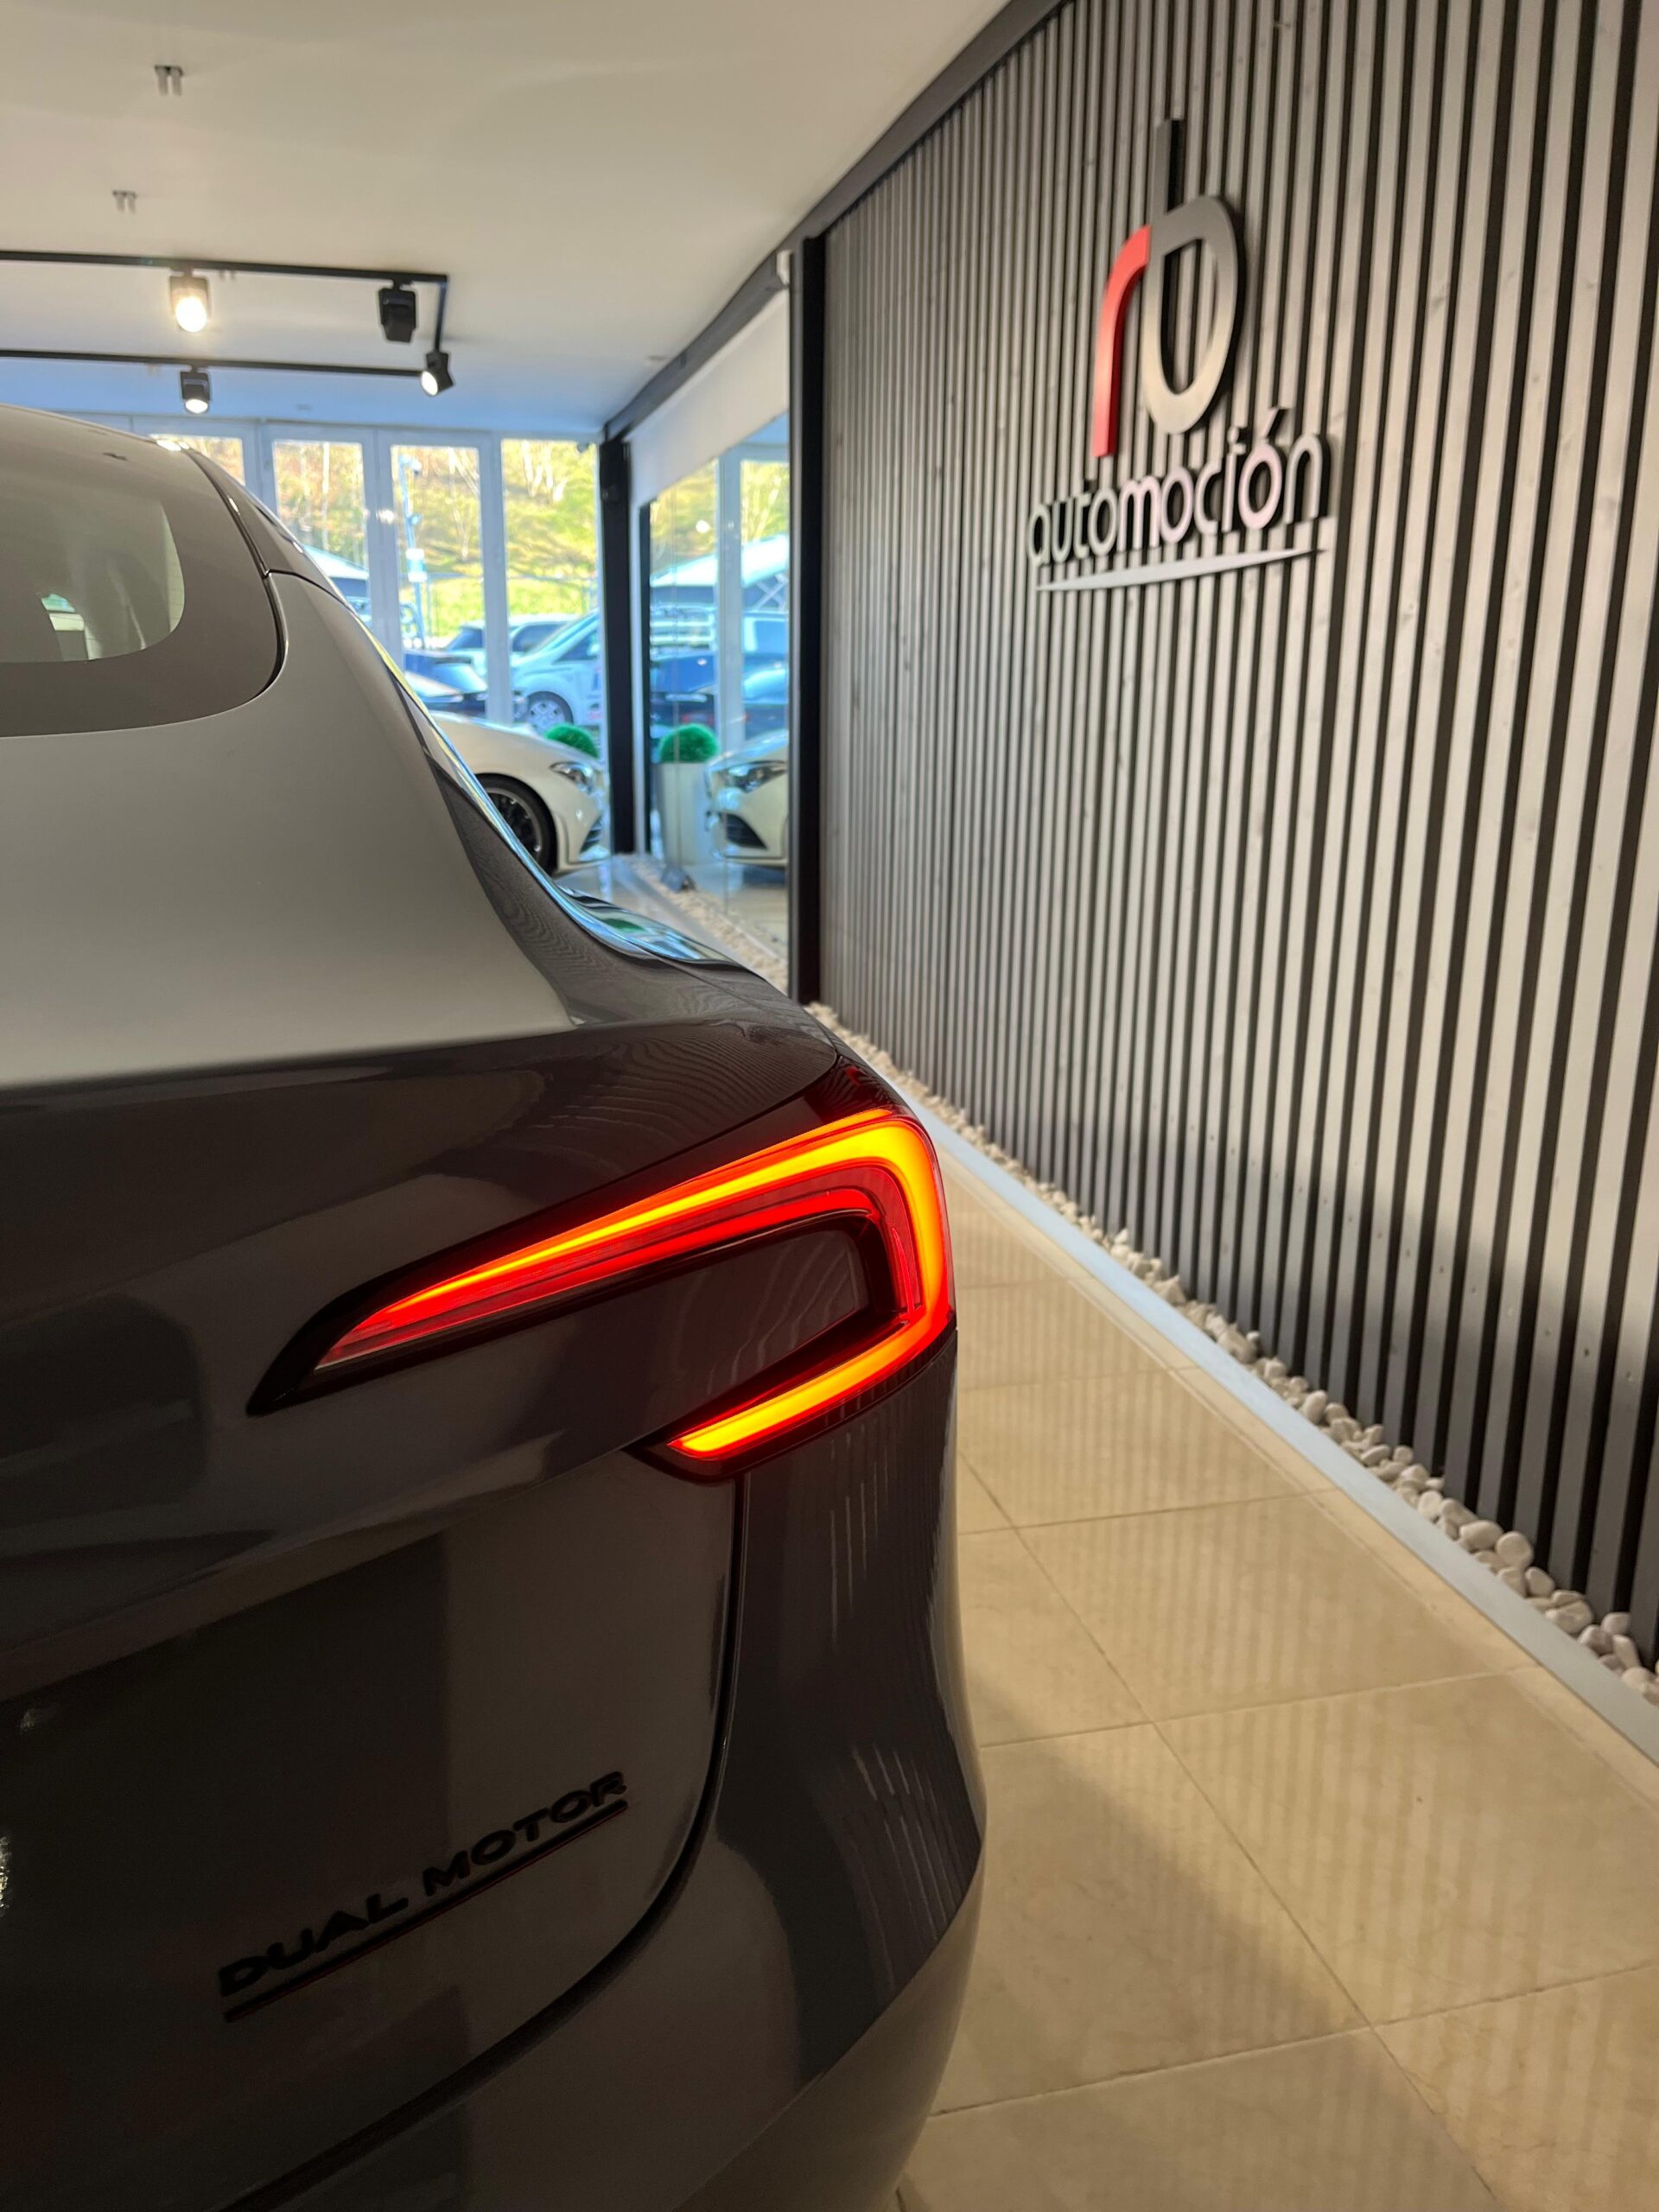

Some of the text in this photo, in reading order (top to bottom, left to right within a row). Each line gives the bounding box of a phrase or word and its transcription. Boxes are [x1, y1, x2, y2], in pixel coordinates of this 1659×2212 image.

[1027, 408, 1325, 565] automoción
[219, 1771, 627, 1997] DUAL MOTOR
